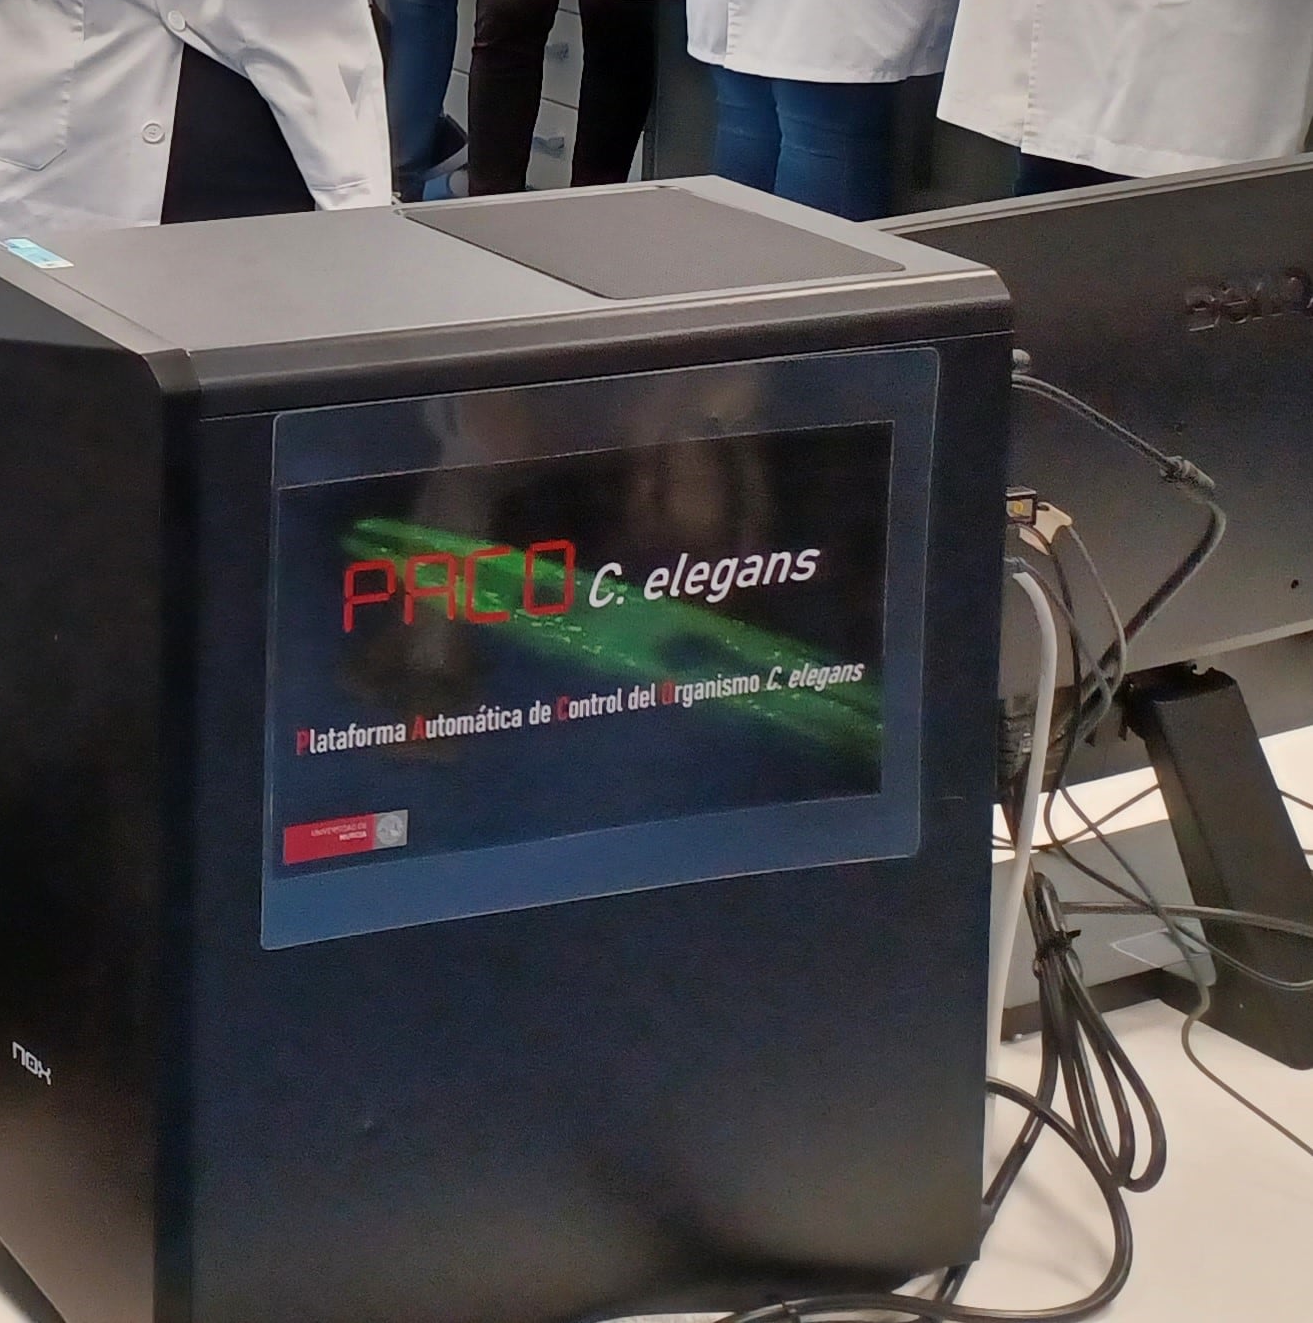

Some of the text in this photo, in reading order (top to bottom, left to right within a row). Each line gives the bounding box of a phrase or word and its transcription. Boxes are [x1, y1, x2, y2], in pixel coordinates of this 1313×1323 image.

[343, 539, 821, 633] PACO C. elegans
[295, 662, 866, 757] Plataforma Automática de Control del Organismo C. elegans
